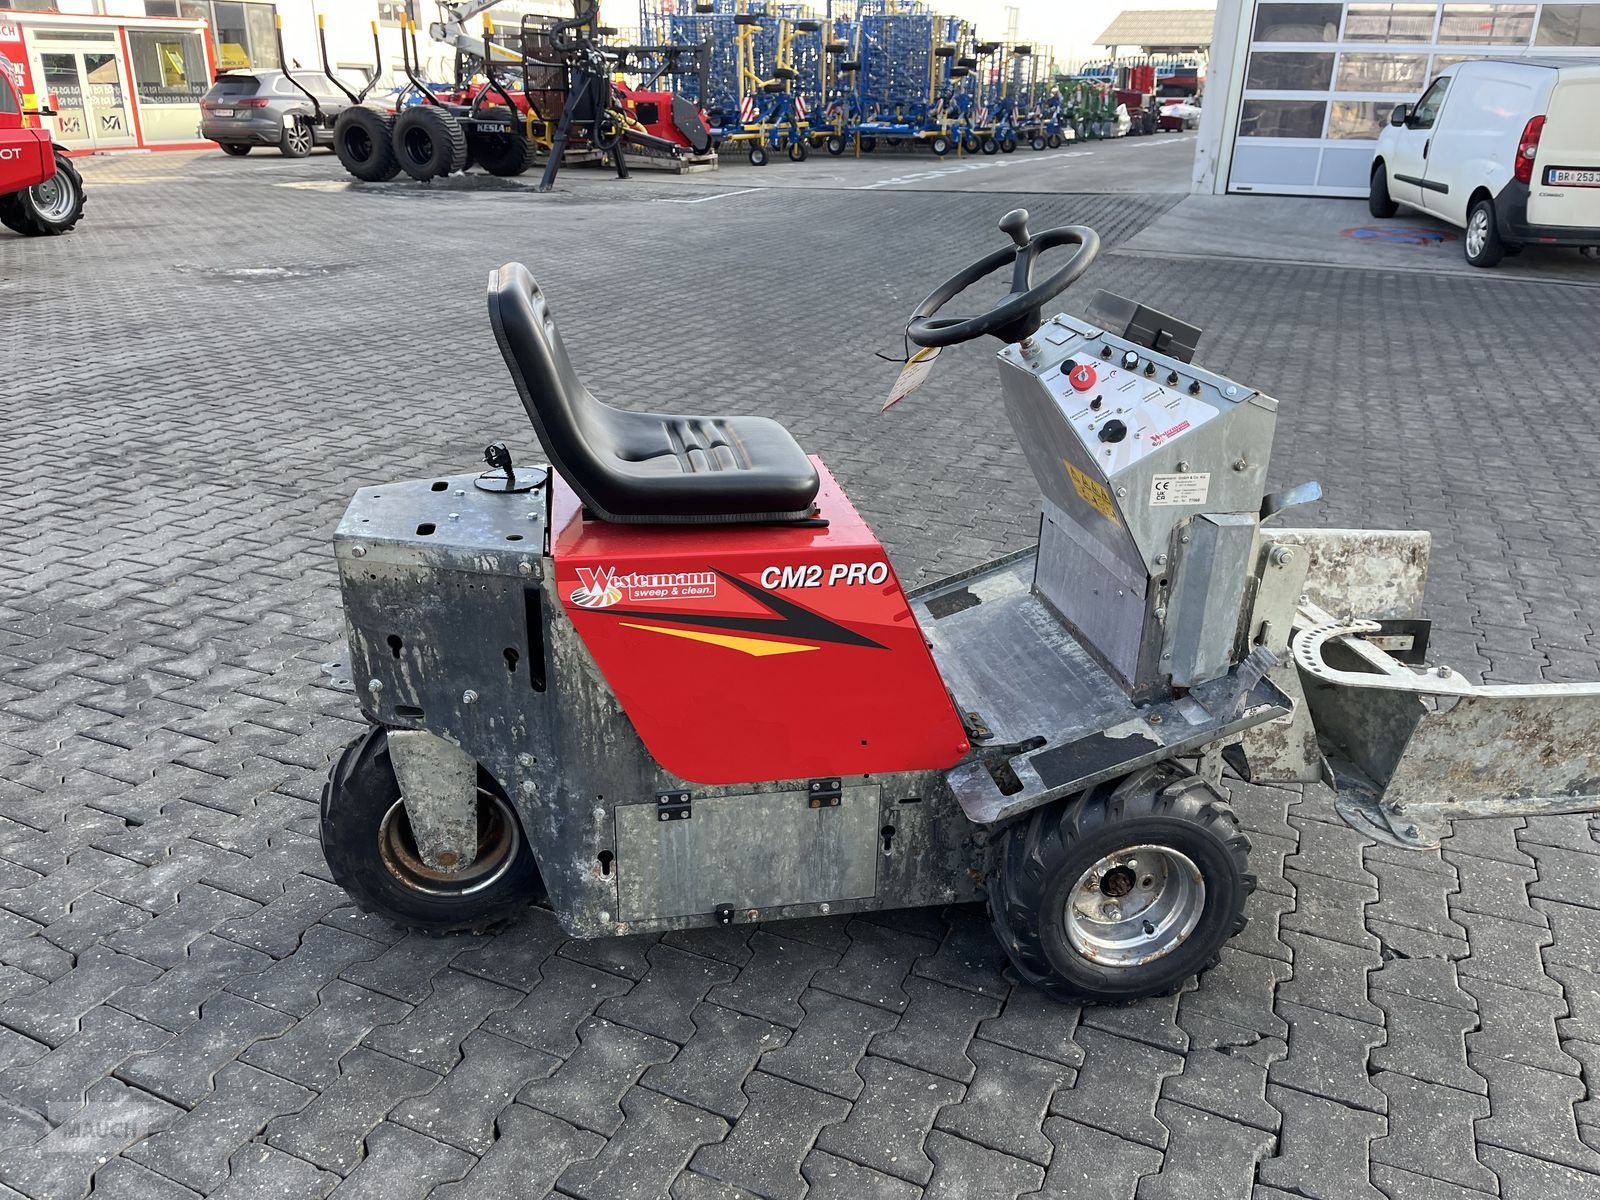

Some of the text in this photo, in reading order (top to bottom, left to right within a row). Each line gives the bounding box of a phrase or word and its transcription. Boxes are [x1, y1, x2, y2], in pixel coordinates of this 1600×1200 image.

[477, 123, 505, 133] KESLA
[1558, 172, 1570, 181] BR
[575, 565, 715, 595] Westermann
[760, 561, 889, 590] CM2 PRO
[633, 585, 713, 597] sweep & clean.
